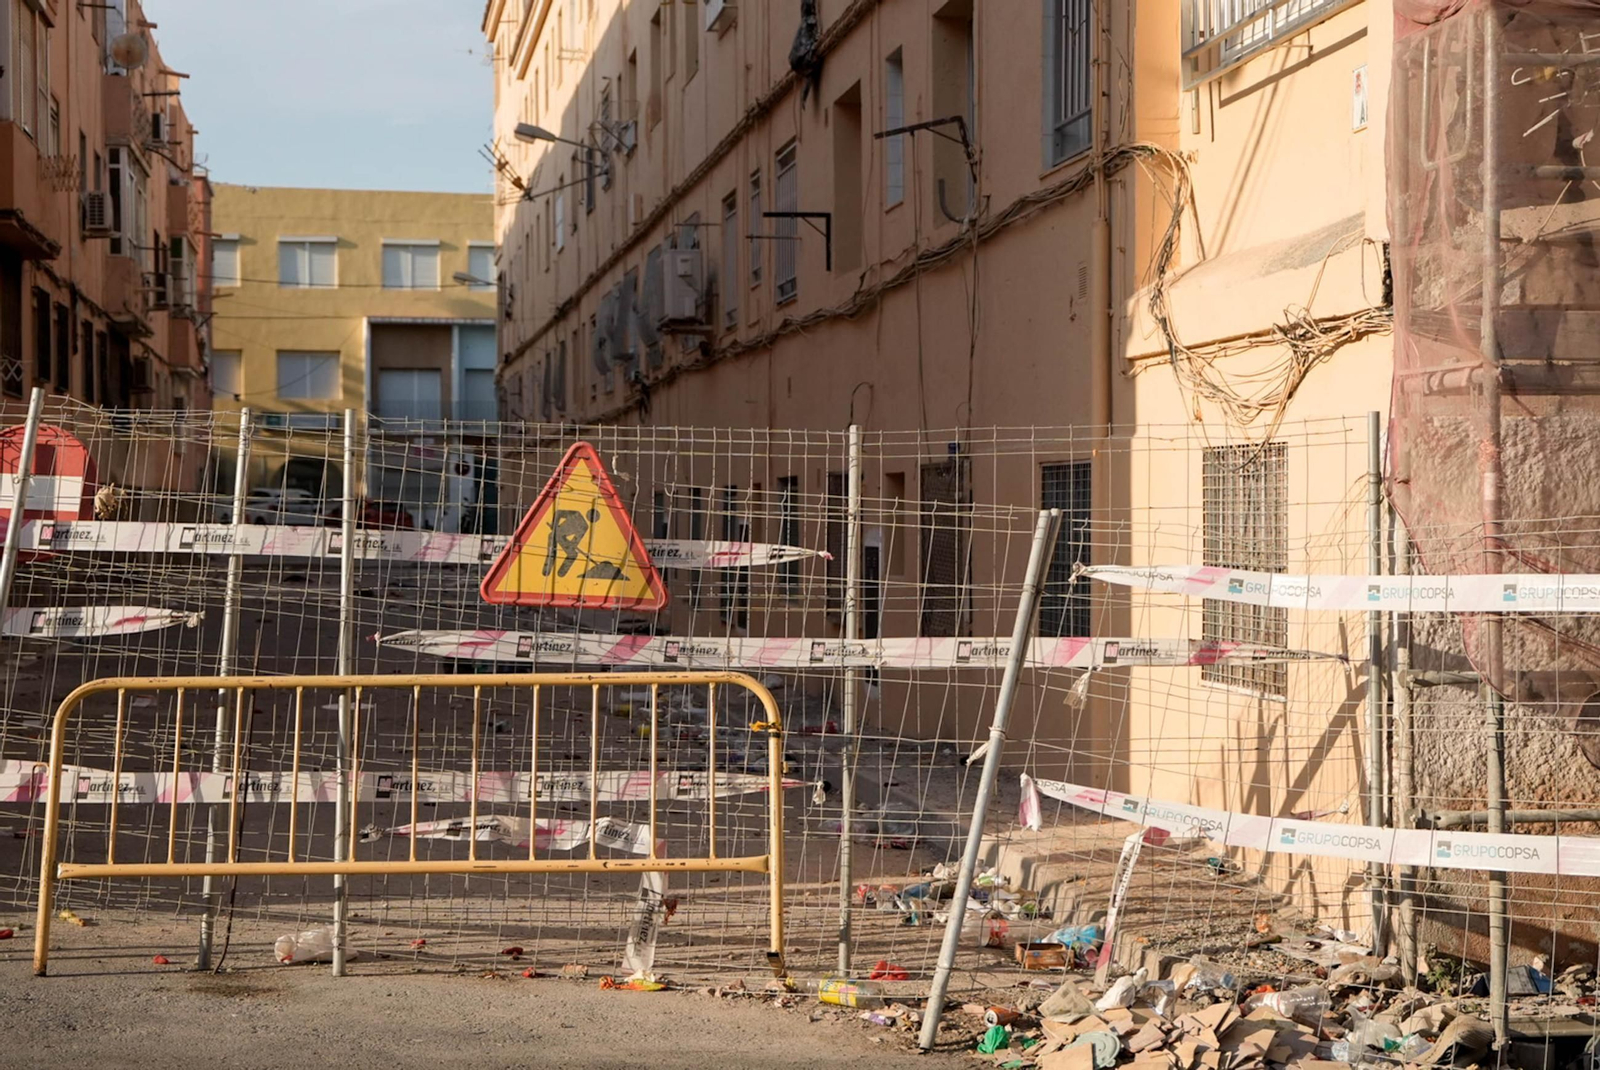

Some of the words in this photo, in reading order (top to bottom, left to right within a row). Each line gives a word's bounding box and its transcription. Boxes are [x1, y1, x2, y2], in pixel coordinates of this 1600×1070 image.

[330, 532, 389, 552] Mrtínez,
[1246, 582, 1322, 598] GRUPOCOPSA
[1382, 587, 1455, 599] GRUPOCOPSA
[1519, 586, 1600, 600] GRUPOCOPS
[1140, 804, 1223, 832] GRUPOCOPSA
[1297, 831, 1381, 850] GRUPOCOPSA
[1453, 844, 1540, 860] GRUPOCOPSA
